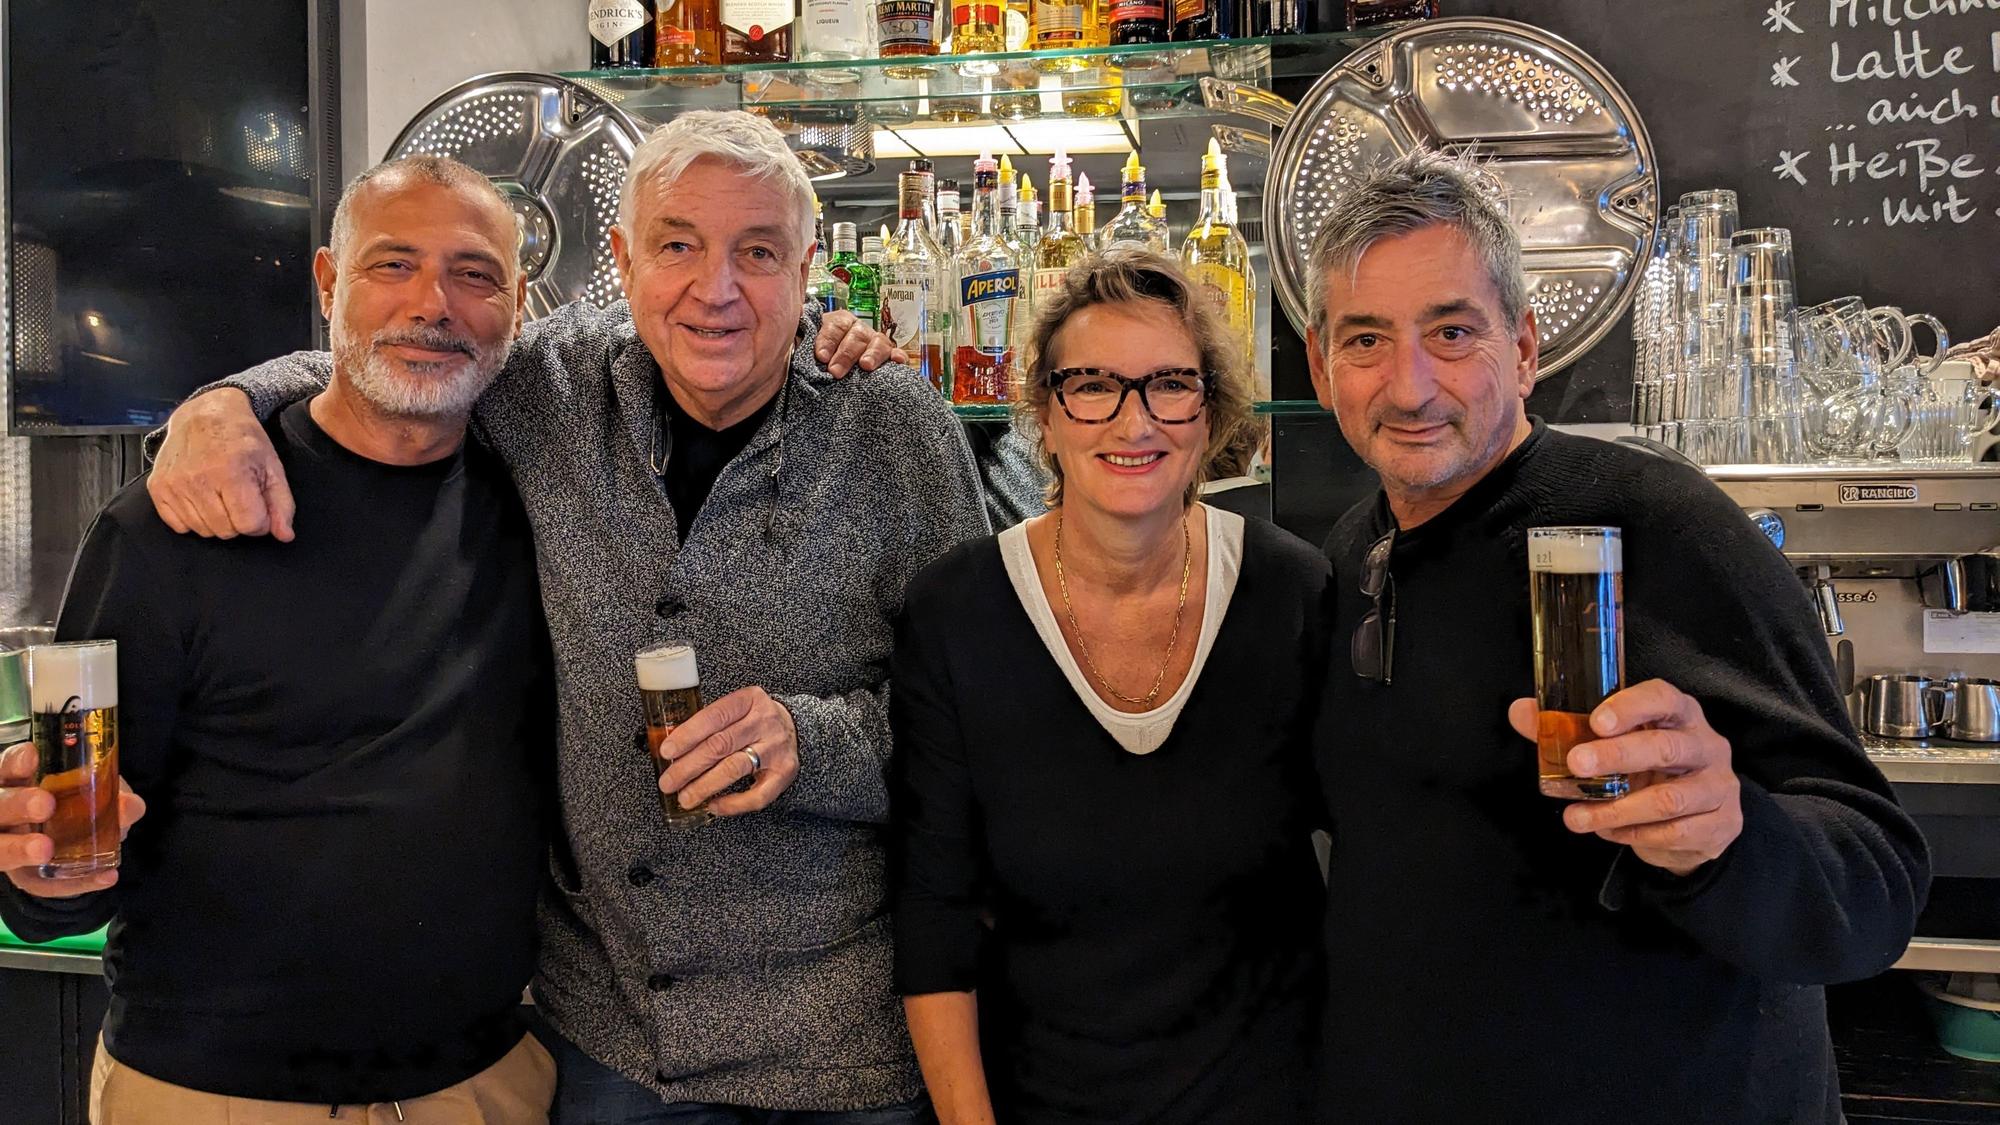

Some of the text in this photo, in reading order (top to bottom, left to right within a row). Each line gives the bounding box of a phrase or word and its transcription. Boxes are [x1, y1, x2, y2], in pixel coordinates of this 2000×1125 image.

[896, 1, 930, 12] MARTIN
[590, 8, 643, 20] ENDRICK'S
[1830, 30, 1974, 82] Latte
[1866, 88, 1979, 126] auch
[967, 276, 1017, 300] APEROL
[887, 288, 915, 301] Morgan
[1861, 488, 1916, 499] RANCILIO
[1836, 590, 1877, 602] sse-6
